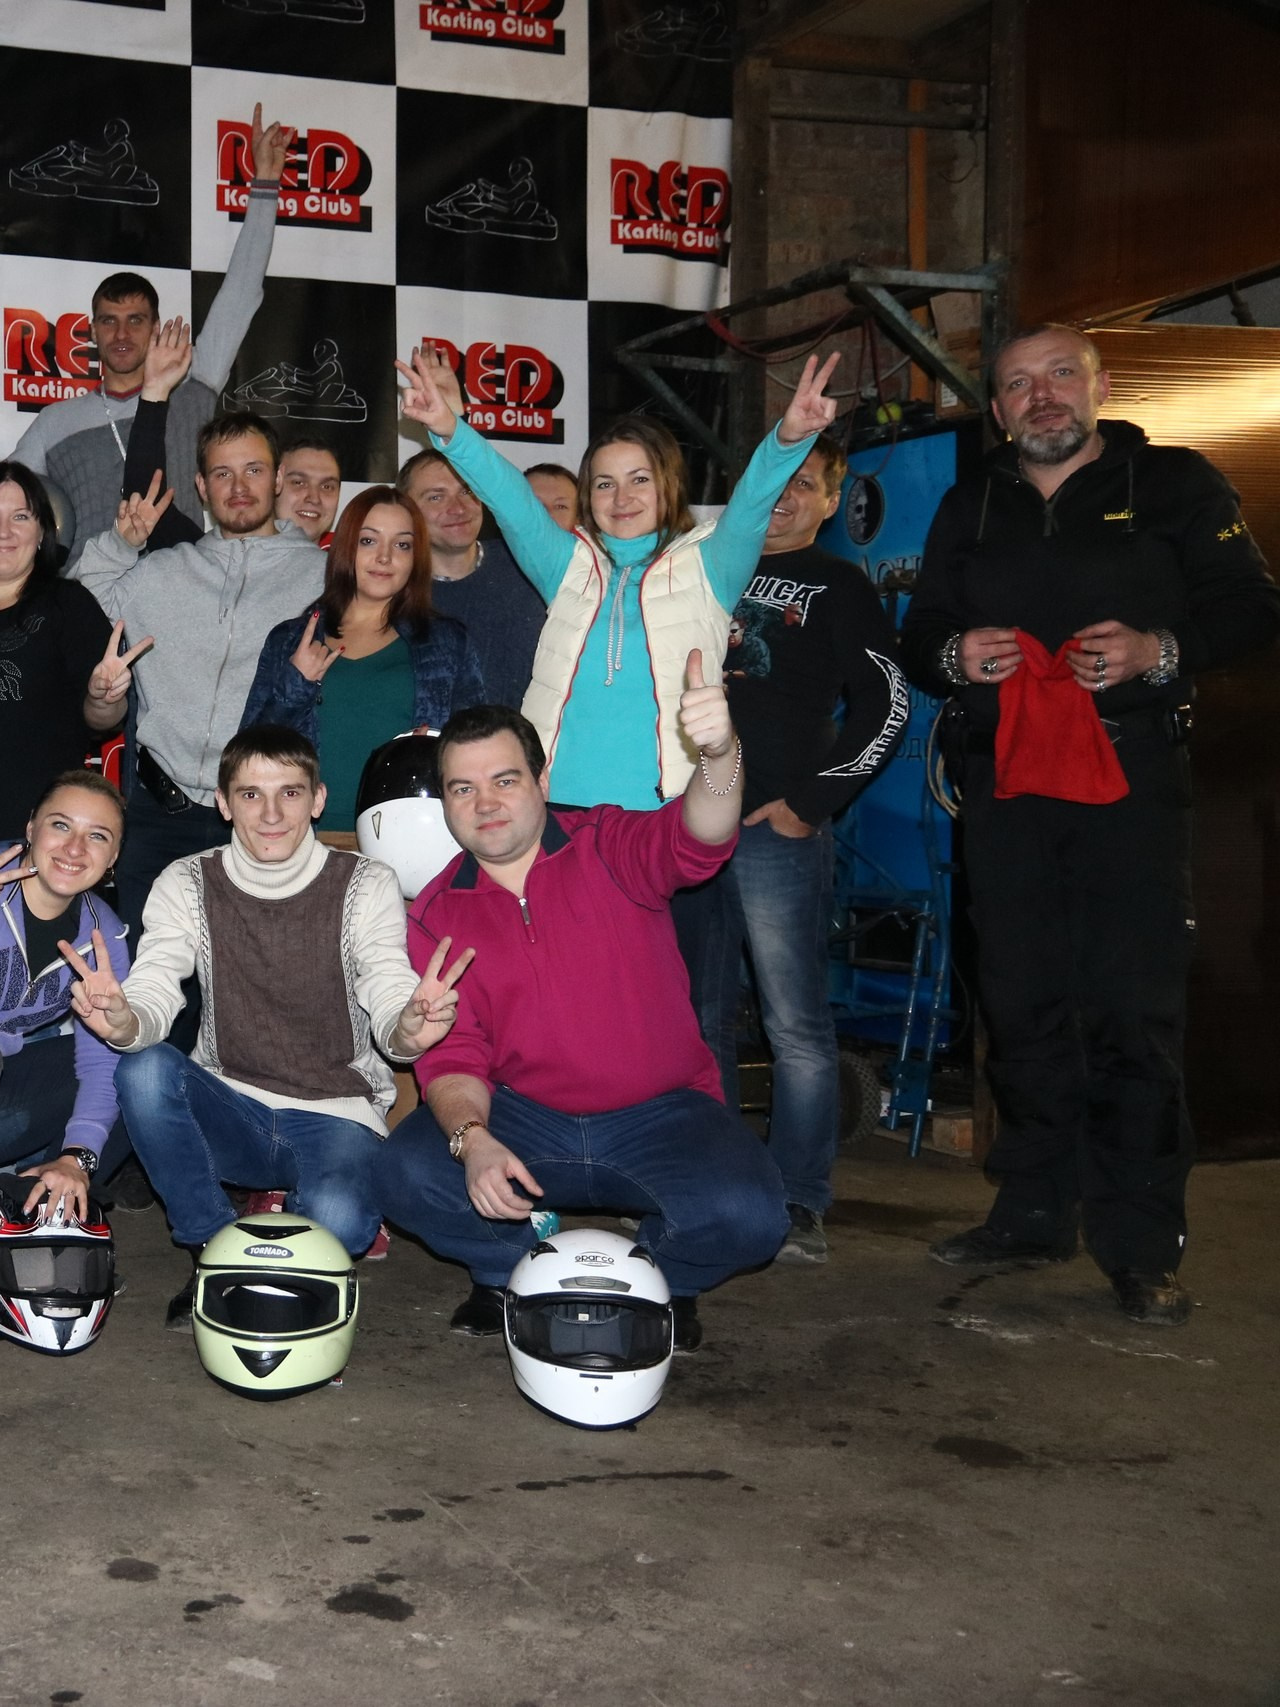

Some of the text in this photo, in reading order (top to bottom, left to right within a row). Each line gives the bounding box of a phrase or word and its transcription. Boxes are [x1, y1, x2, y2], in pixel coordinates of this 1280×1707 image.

[426, 8, 546, 38] Karting Club
[611, 158, 730, 224] RED
[304, 195, 352, 216] Club
[617, 222, 678, 249] Karting
[4, 308, 90, 375] RE
[501, 409, 546, 429] Club
[250, 1247, 289, 1257] TORNADO
[574, 1255, 615, 1264] sparco
